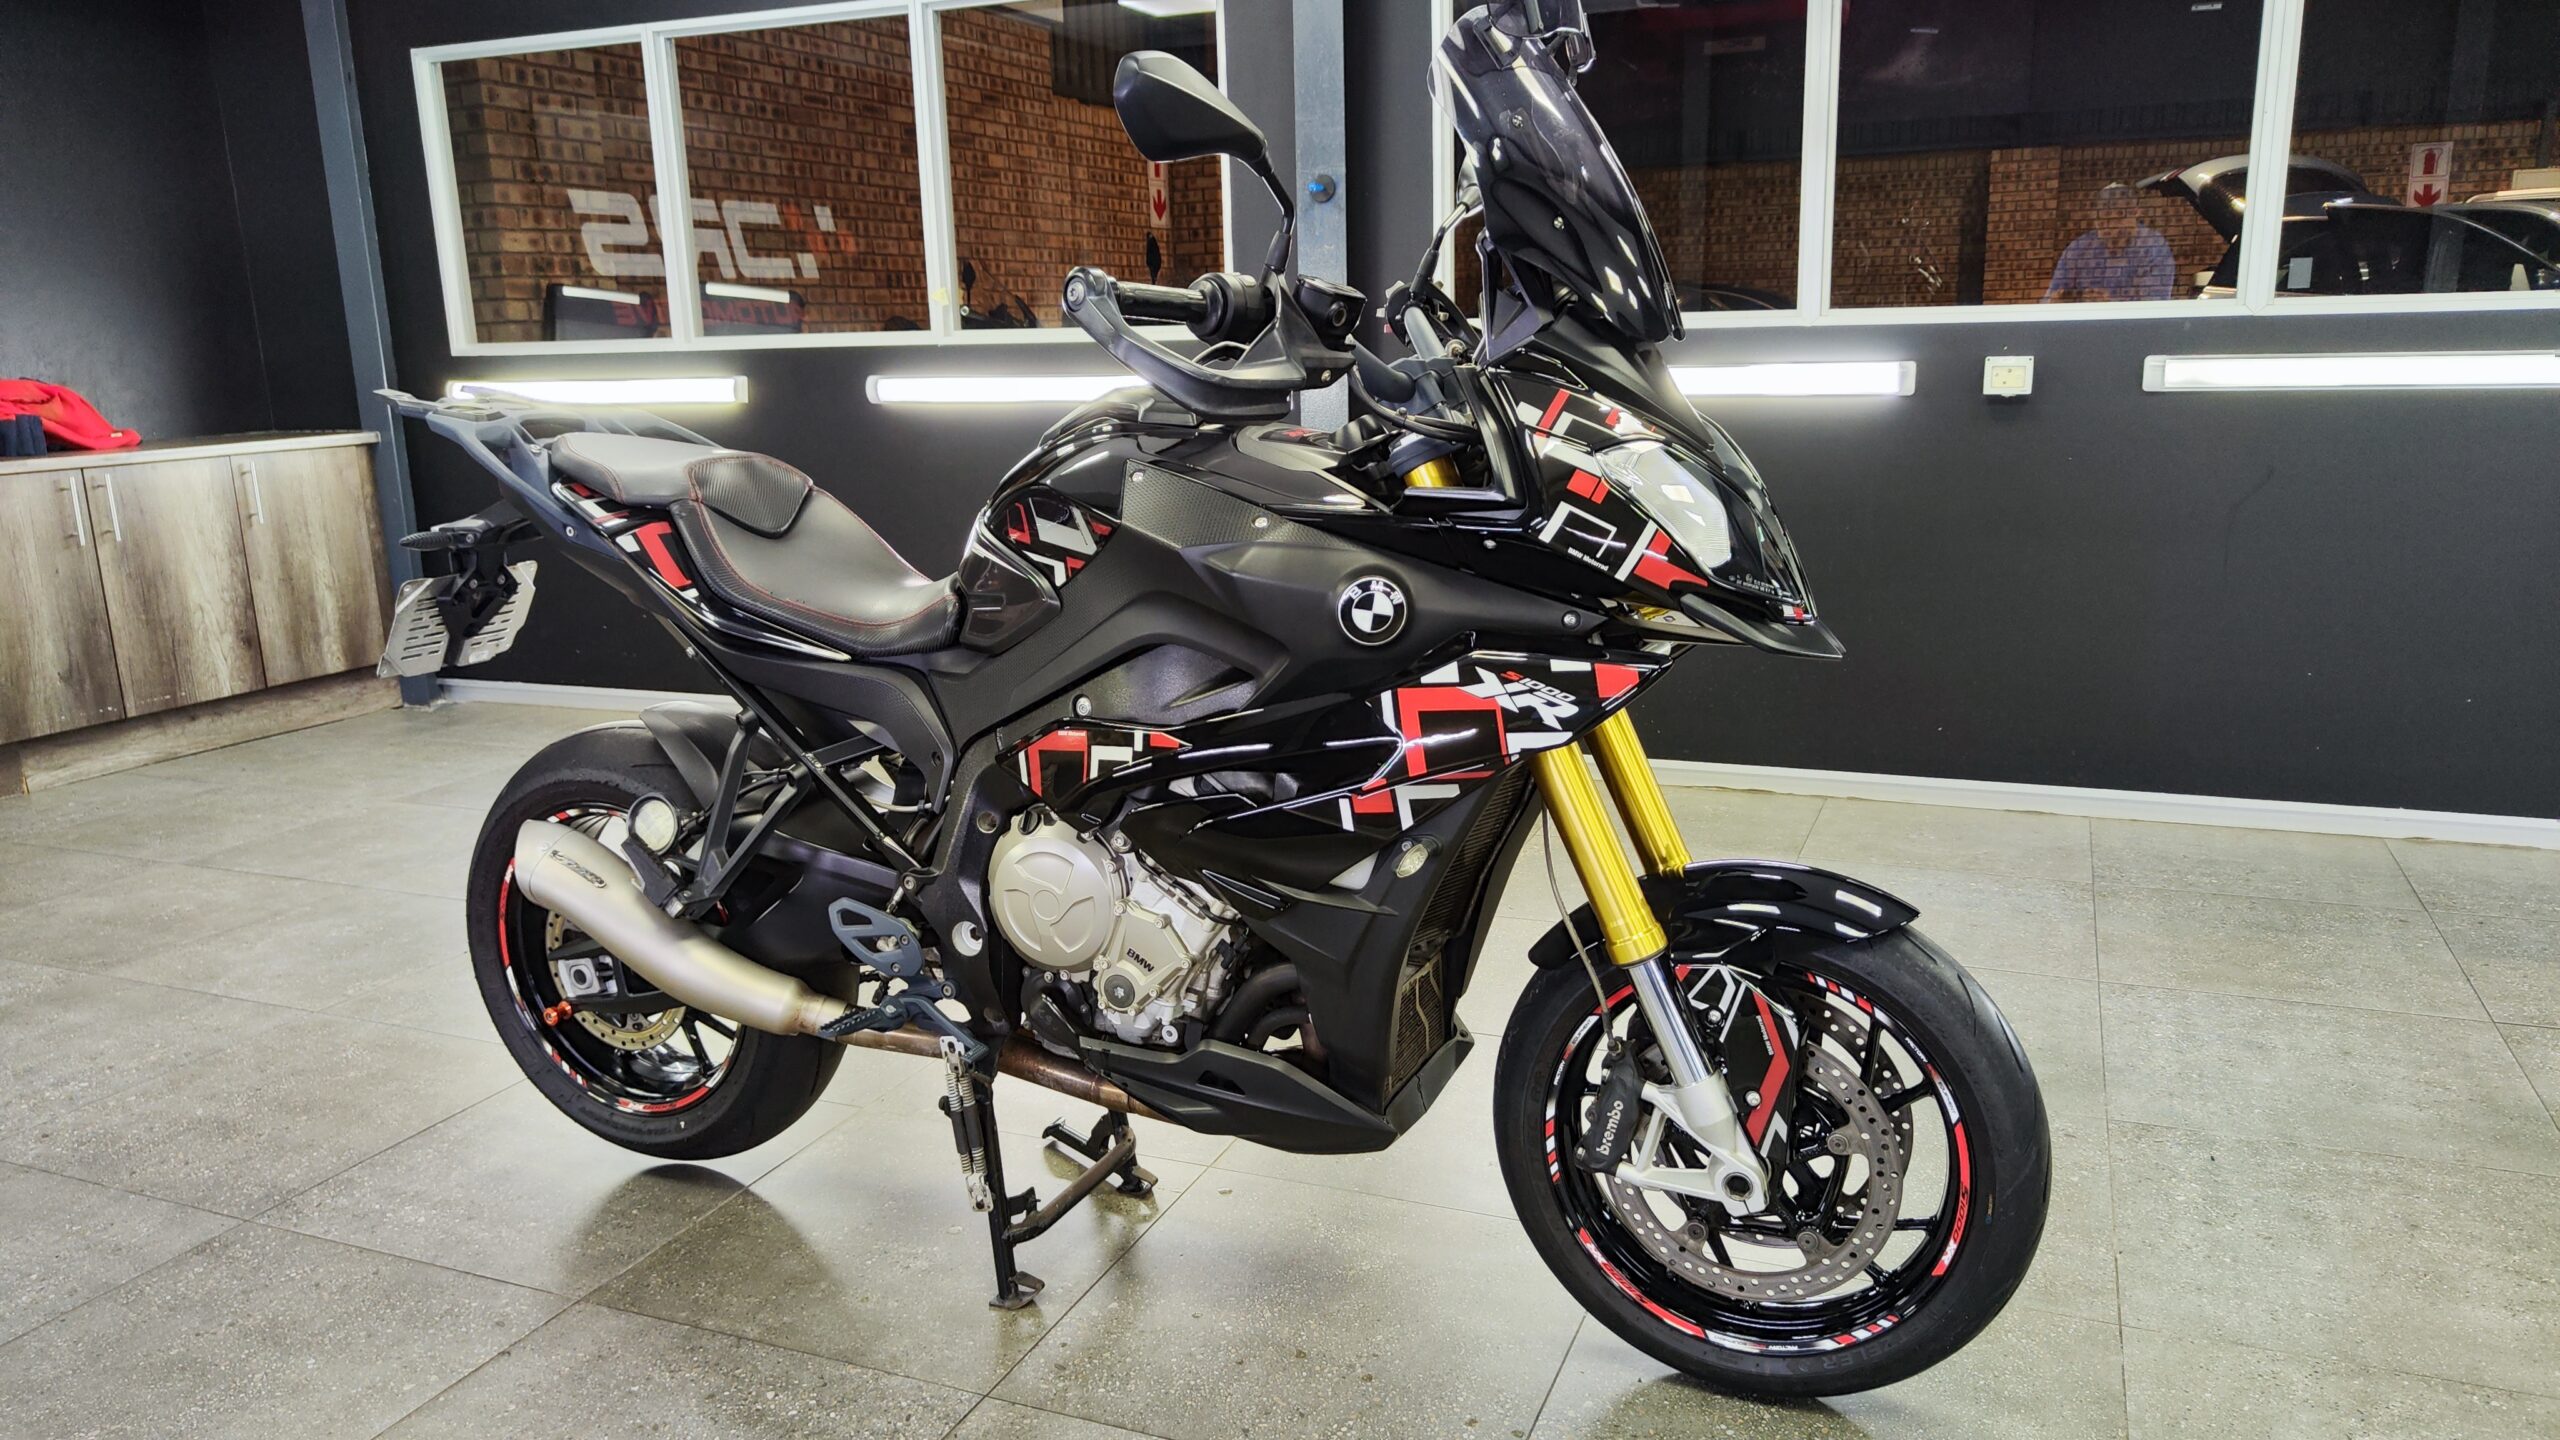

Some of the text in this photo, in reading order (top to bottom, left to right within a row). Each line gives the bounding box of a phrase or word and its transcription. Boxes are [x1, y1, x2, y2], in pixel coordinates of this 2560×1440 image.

[1568, 546, 1609, 571] BMW Motorrad
[1349, 580, 1403, 605] BMW
[1456, 665, 1579, 731] XR
[1500, 671, 1577, 702] S1000
[1127, 947, 1155, 972] BMW
[1905, 1036, 1928, 1063] FACTORY
[1553, 1059, 1566, 1085] FACTORY
[1595, 1100, 1624, 1156] brembo
[1953, 1186, 1969, 1244] S1000
